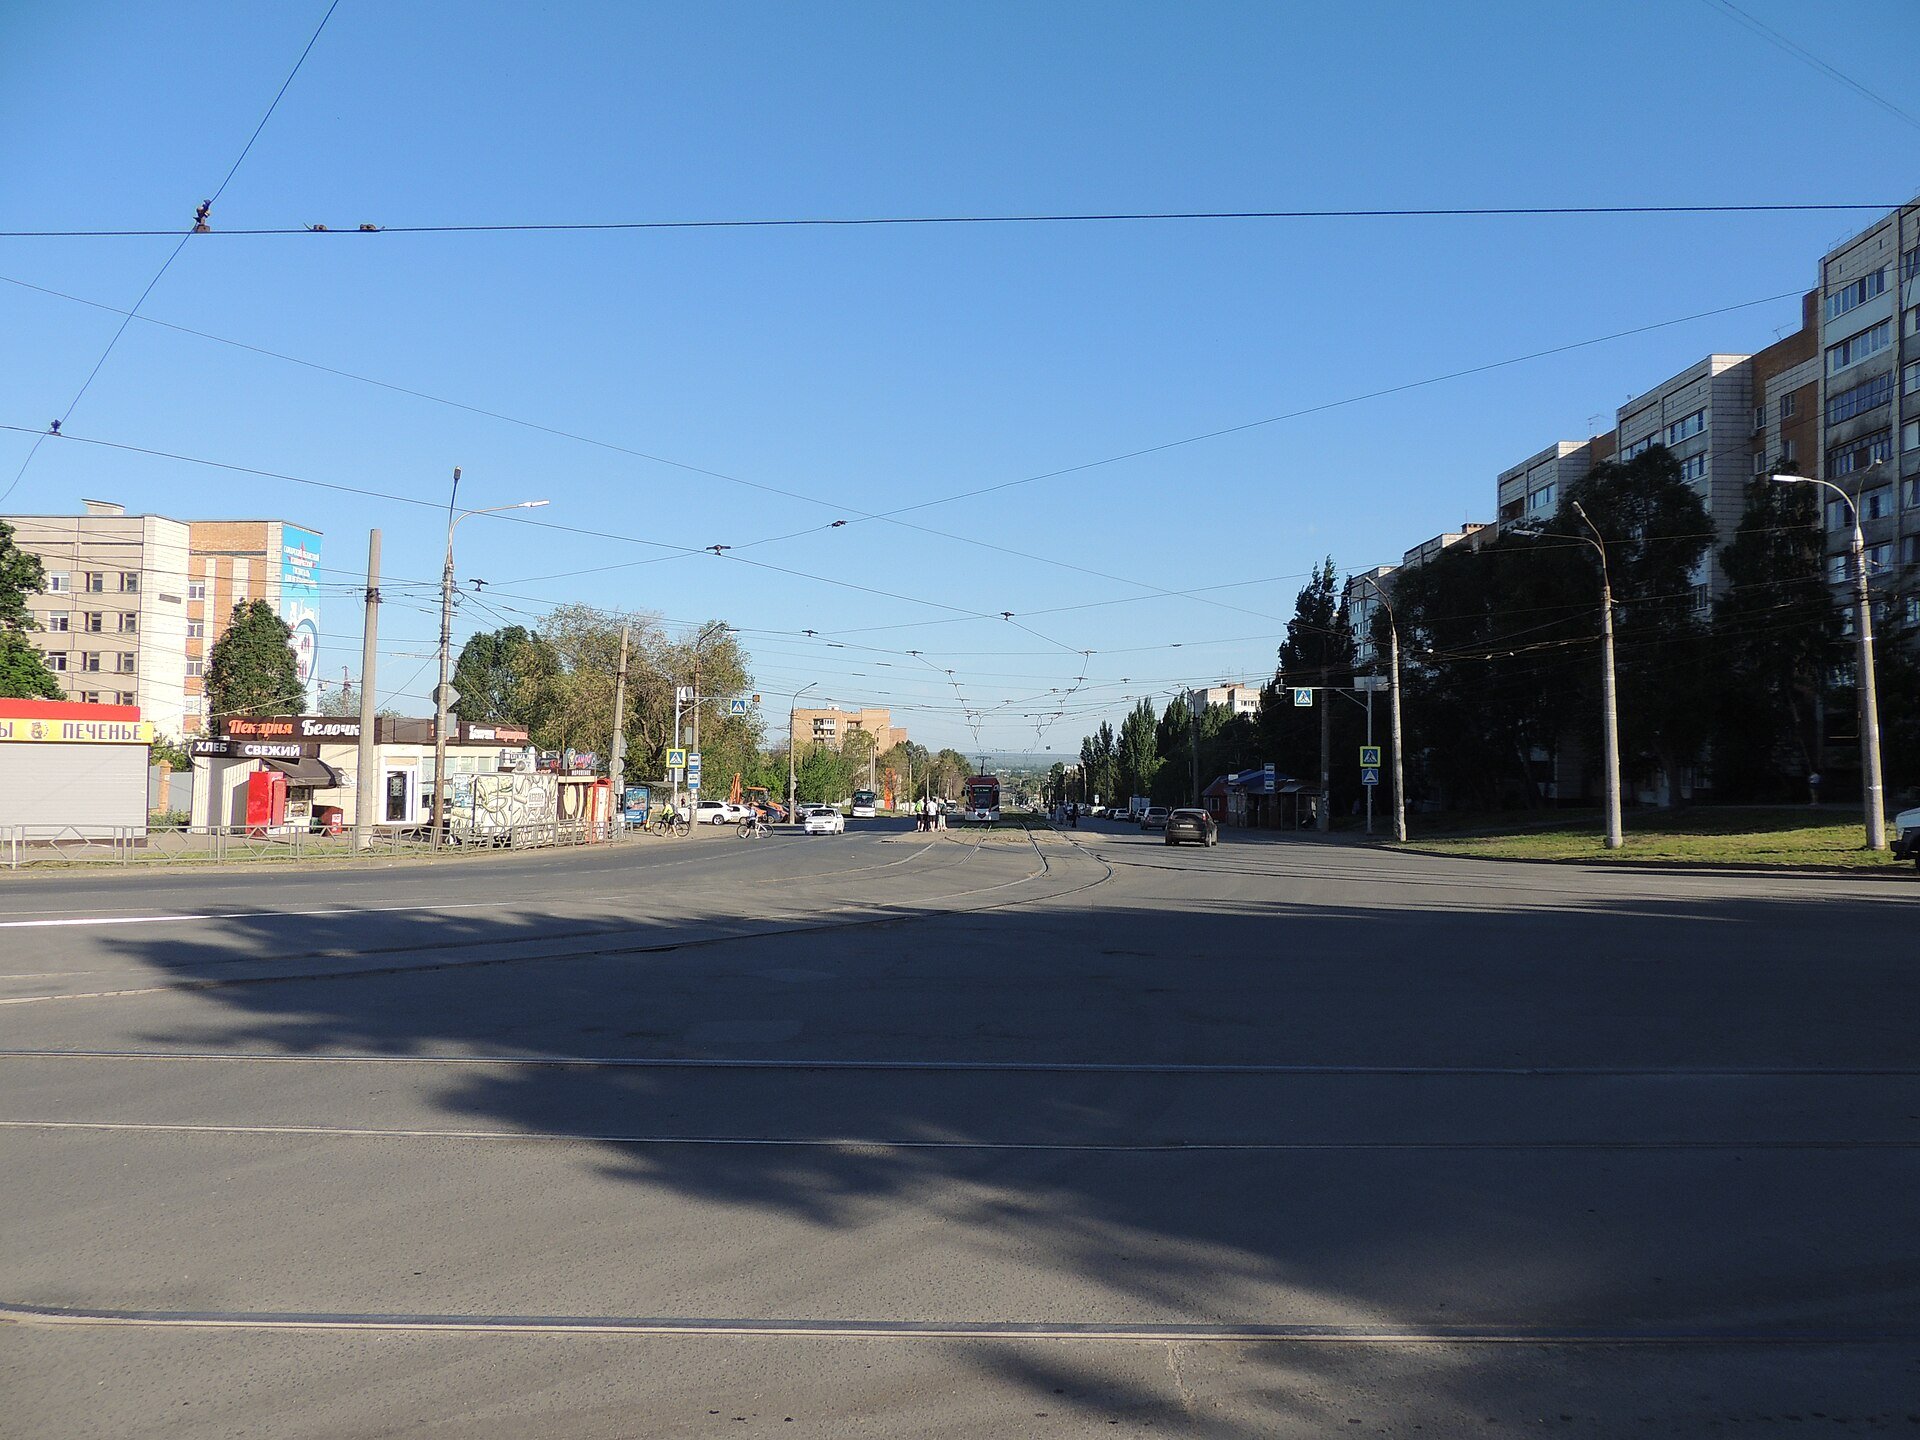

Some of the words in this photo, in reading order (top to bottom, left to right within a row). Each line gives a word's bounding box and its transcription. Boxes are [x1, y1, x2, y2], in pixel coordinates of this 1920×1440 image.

[62, 722, 142, 741] ПЕЧЕНЬЕ
[228, 719, 293, 738] Пекарня
[301, 719, 361, 736] Белочк
[195, 741, 228, 753] ХЛЕБ
[244, 744, 301, 757] СВЕЖИЙ
